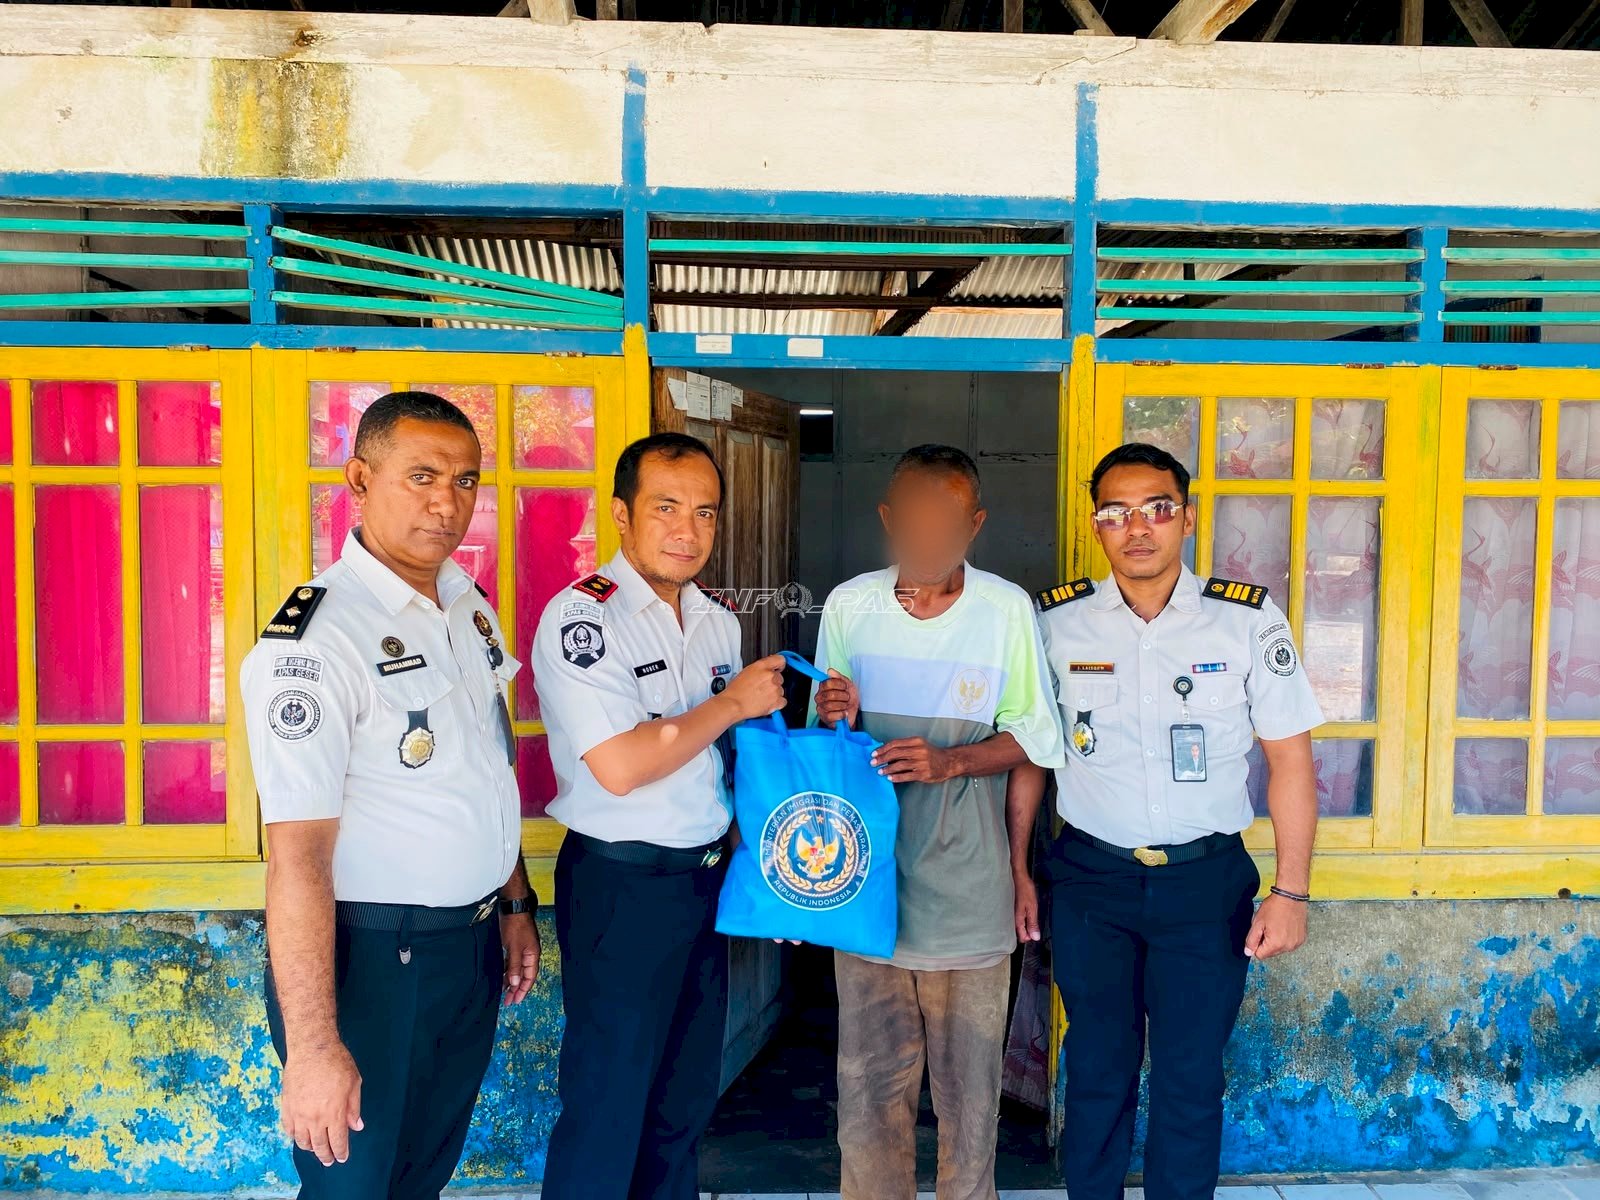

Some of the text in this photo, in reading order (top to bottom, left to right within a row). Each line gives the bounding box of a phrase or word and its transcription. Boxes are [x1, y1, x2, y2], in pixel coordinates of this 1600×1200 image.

[383, 658, 422, 672] MUHAMMAD
[273, 667, 319, 682] LAPAS GESER
[787, 797, 821, 813] IMIGRASI
[822, 797, 839, 809] DAN
[773, 879, 853, 907] REPUBLIK INDONESIA
